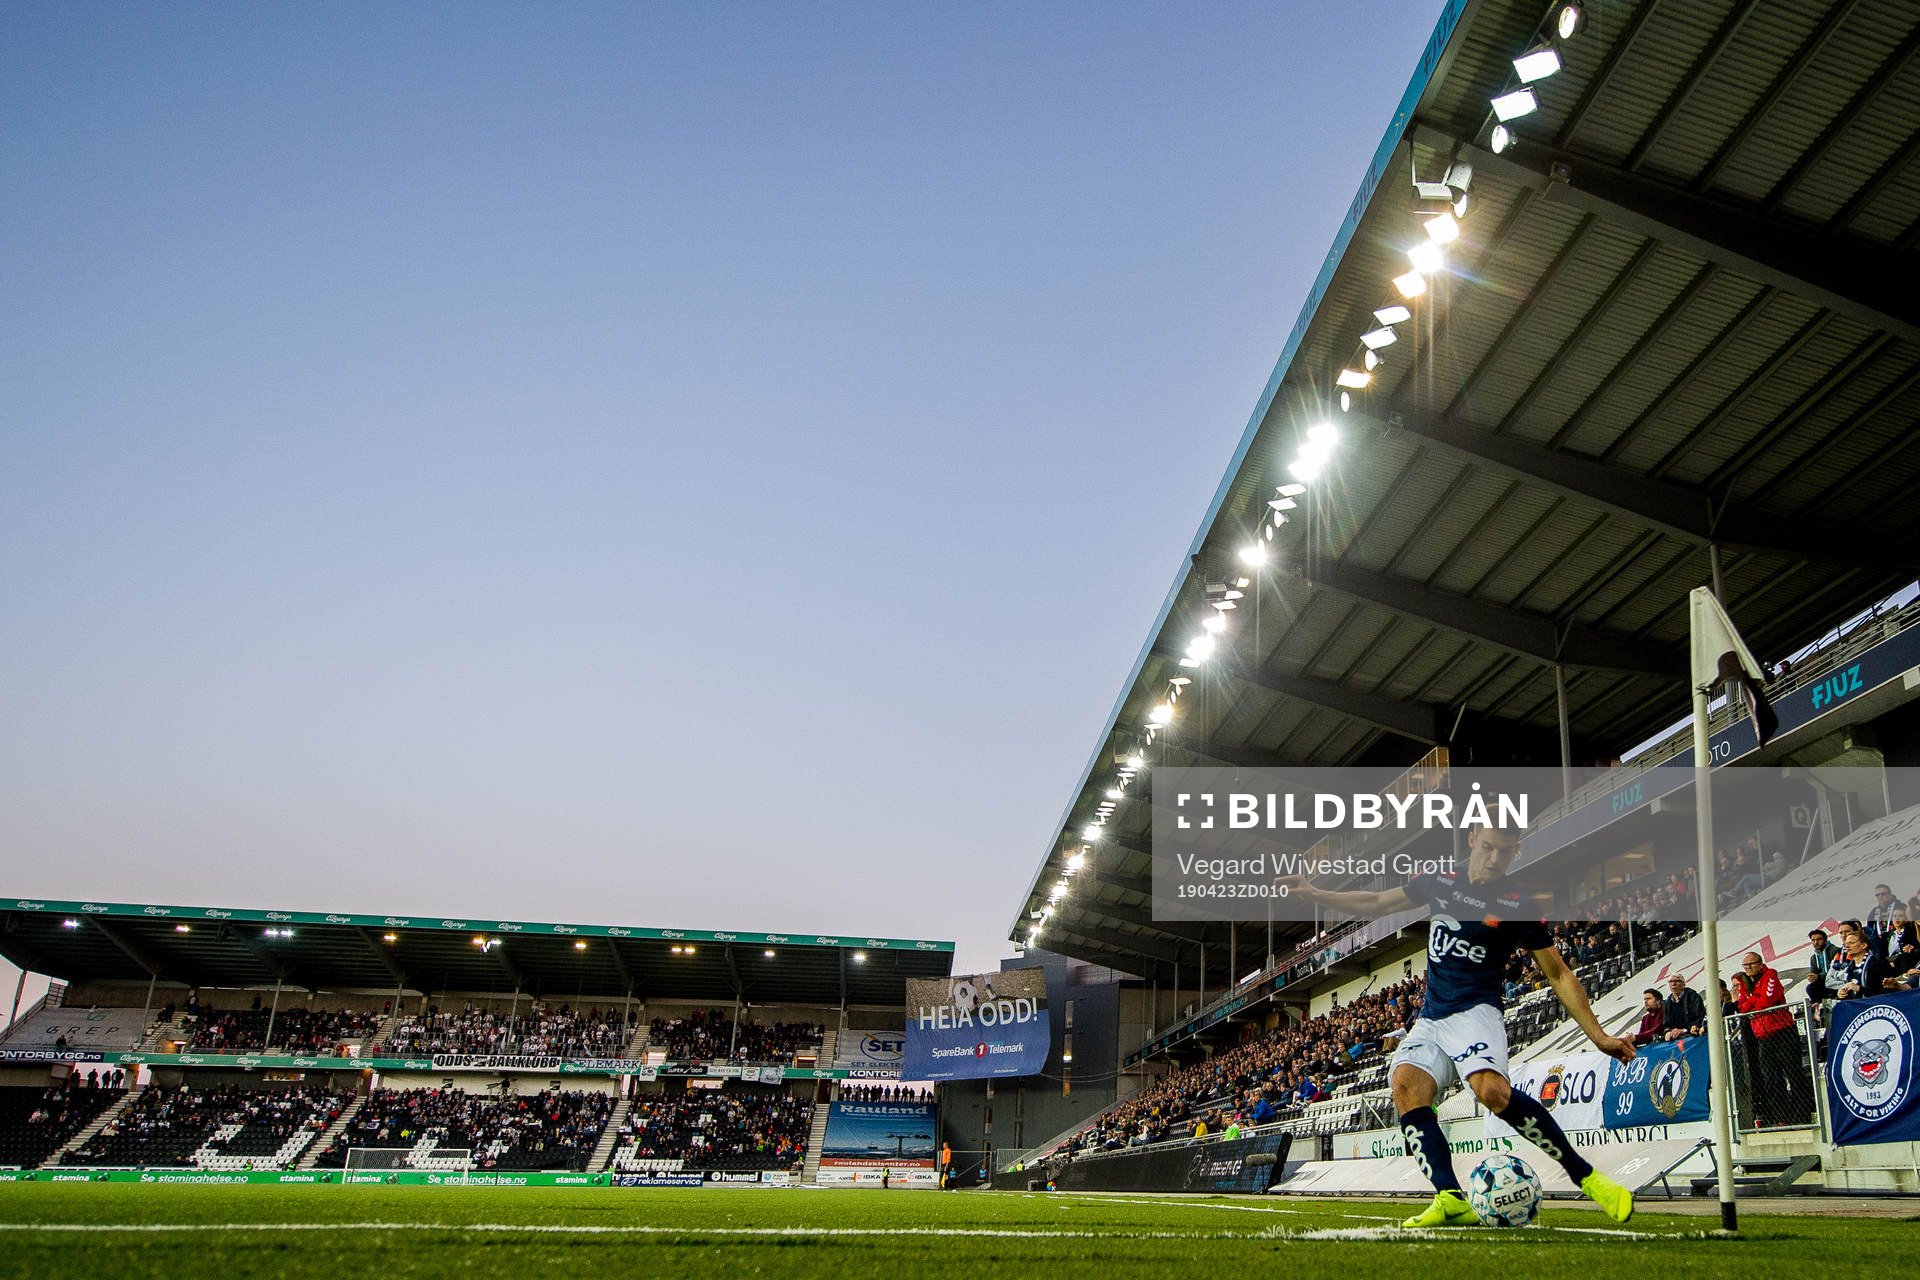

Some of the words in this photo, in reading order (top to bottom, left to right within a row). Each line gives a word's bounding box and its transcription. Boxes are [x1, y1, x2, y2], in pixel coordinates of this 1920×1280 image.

[1811, 663, 1863, 710] FJUZ
[1611, 782, 1644, 813] FJUZ
[1463, 896, 1487, 909] OBOS
[1432, 925, 1487, 963] Lyse
[919, 1002, 973, 1030] HEIA
[978, 997, 1038, 1027] ODD!
[46, 1026, 120, 1035] GREP
[868, 1039, 905, 1052] SET
[931, 1046, 975, 1059] SpareBank
[988, 1042, 1024, 1055] Telemark
[436, 1055, 472, 1067] ODDS
[488, 1056, 557, 1068] BALLKLUBB
[1616, 1090, 1634, 1116] 99
[1844, 1093, 1859, 1111] ALT
[1859, 1105, 1879, 1118] FOR
[1879, 1087, 1904, 1116] VIKING
[840, 1104, 928, 1115] Rauland
[52, 1174, 90, 1182] stamina
[140, 1173, 155, 1183] Se
[158, 1173, 249, 1183] staminahelse.no
[279, 1174, 315, 1182] stamina
[347, 1175, 381, 1183] stamina
[427, 1175, 441, 1184] Se
[443, 1174, 527, 1185] staminahelse.no
[555, 1176, 588, 1184] stamina
[637, 1177, 701, 1186] reklameservice
[721, 1171, 758, 1182] hummel
[1494, 1186, 1531, 1208] SELECT
